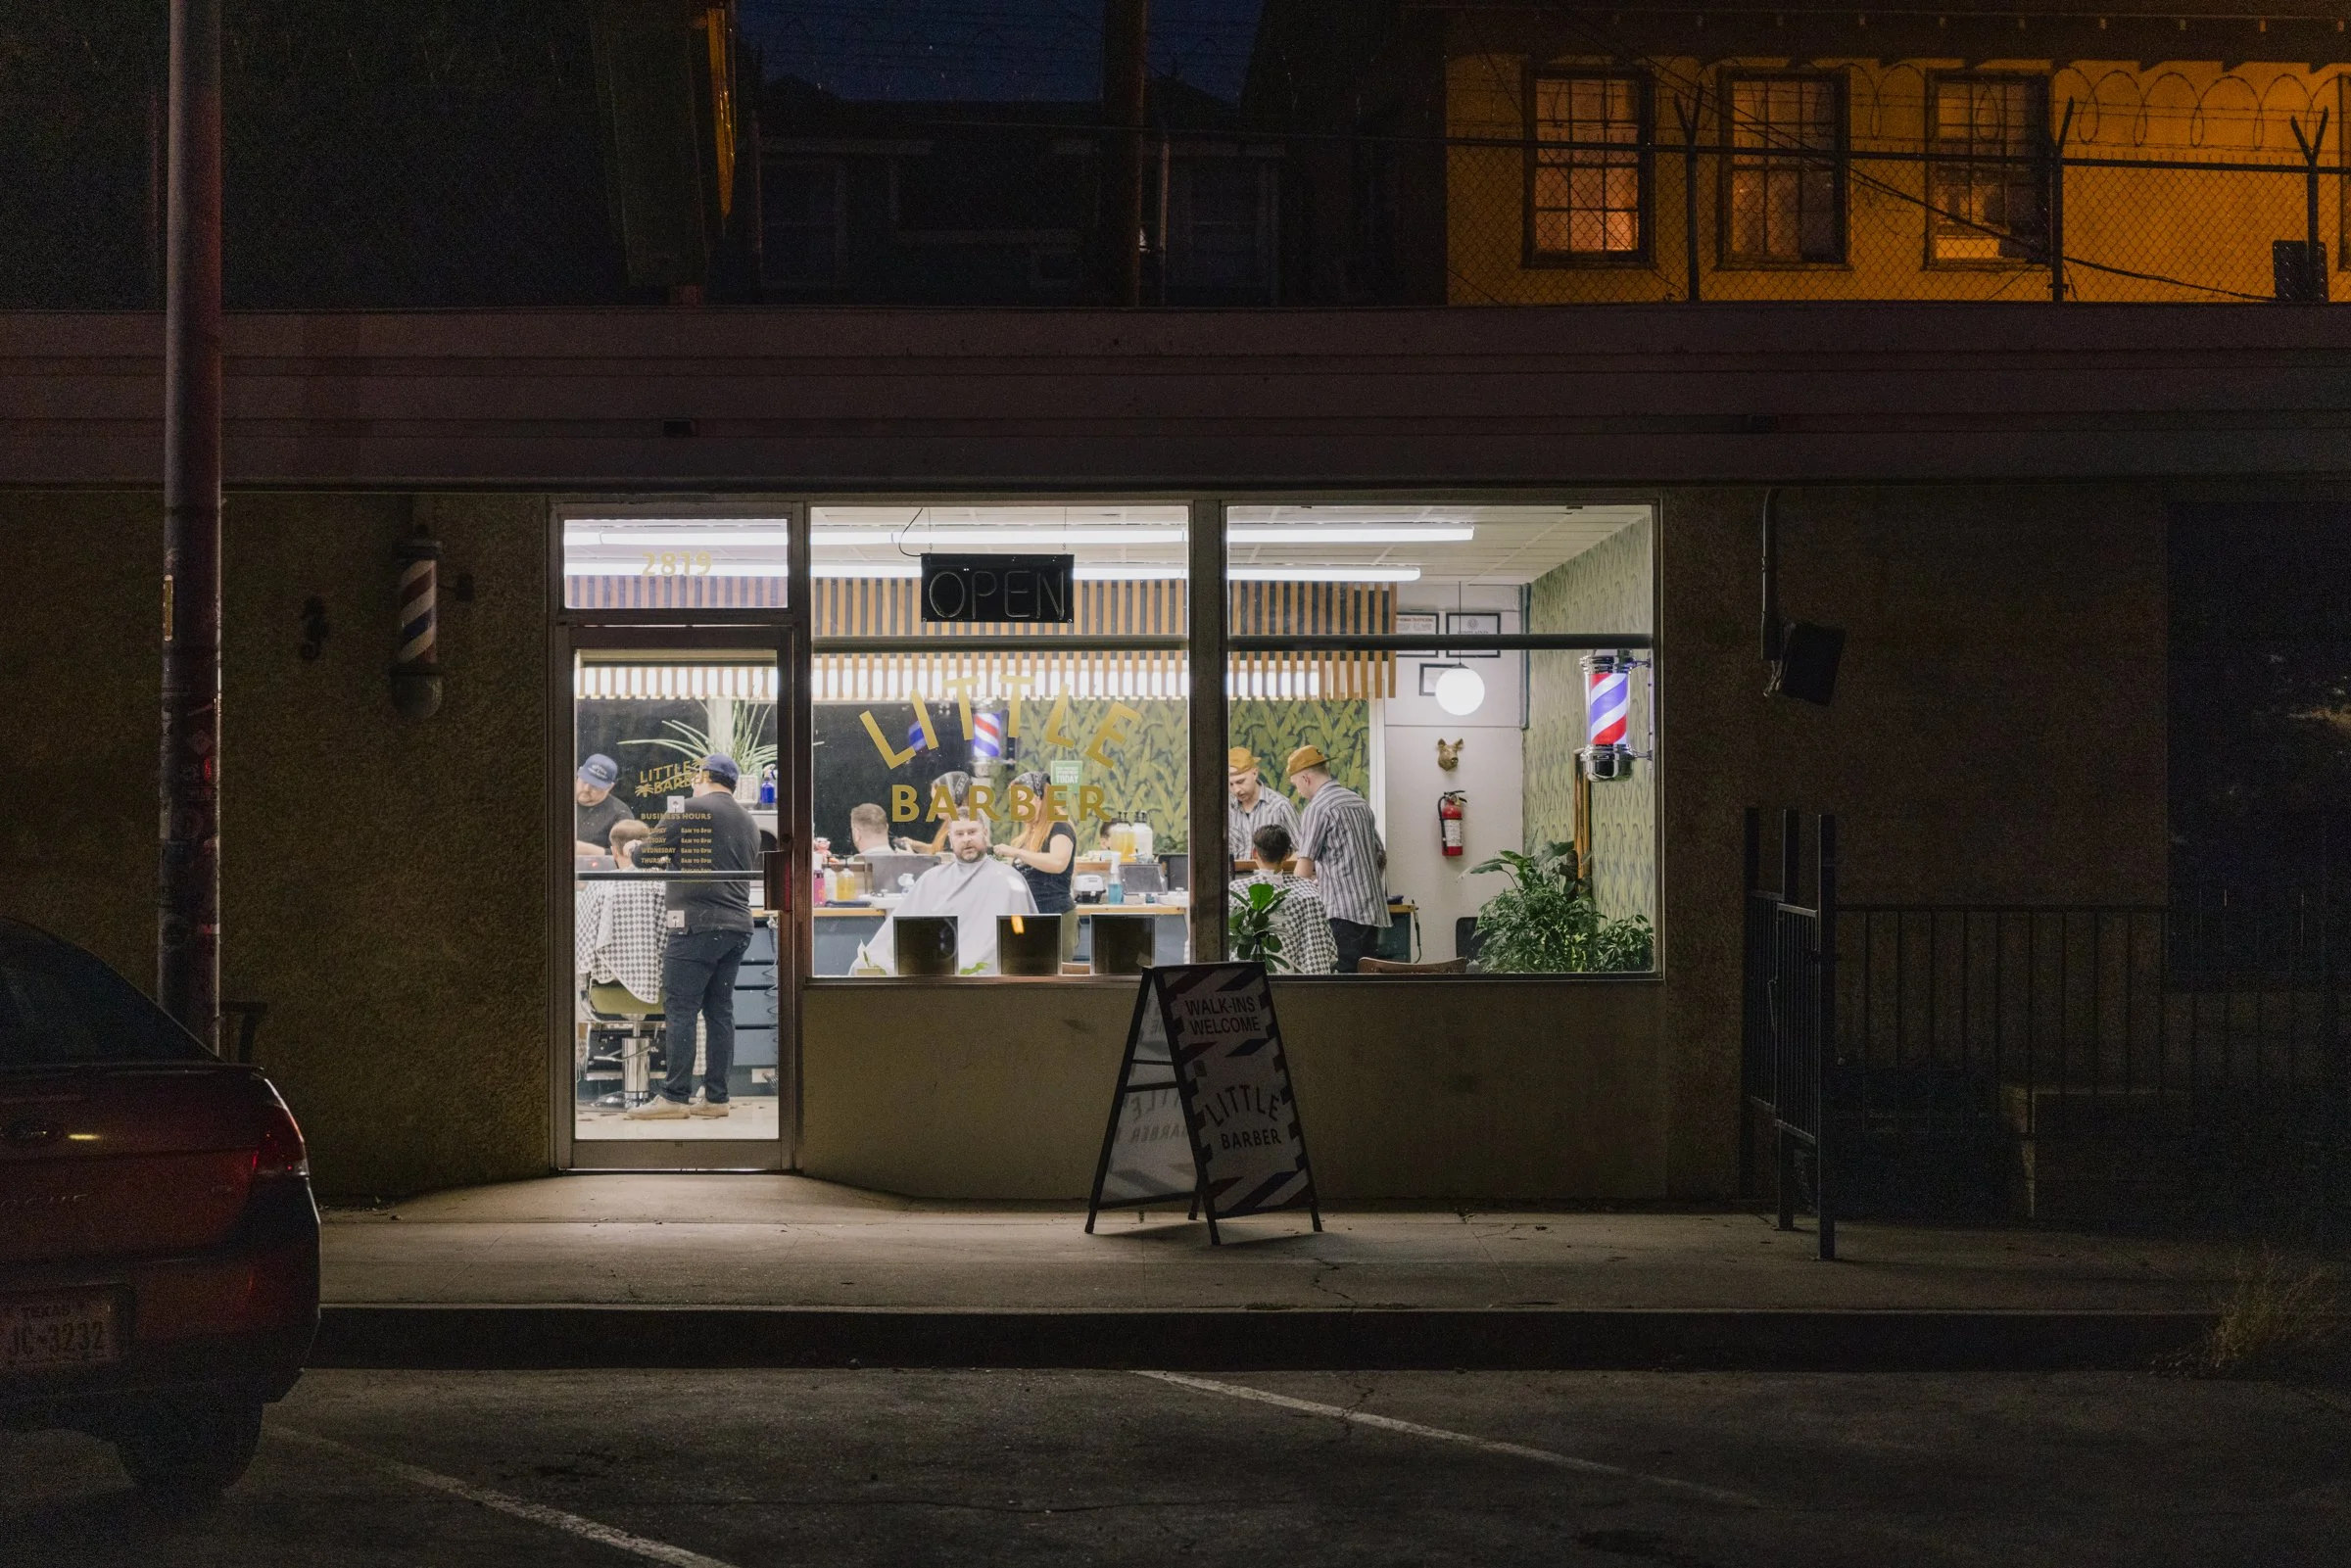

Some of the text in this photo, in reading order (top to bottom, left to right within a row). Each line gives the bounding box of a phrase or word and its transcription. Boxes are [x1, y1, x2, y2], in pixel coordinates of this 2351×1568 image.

[642, 550, 712, 577] 2819
[929, 570, 1065, 620] OPEN
[858, 674, 1143, 770] LITTLE
[640, 760, 692, 784] LITTLE
[1056, 775, 1079, 784] TODAY
[891, 784, 1113, 823] BARBER
[1185, 996, 1256, 1016] WALK-INS
[1189, 1017, 1261, 1035] WELCOME
[1205, 1084, 1280, 1127] LITTLE
[1221, 1128, 1282, 1150] BARBER
[22, 1306, 71, 1318] TEXAS
